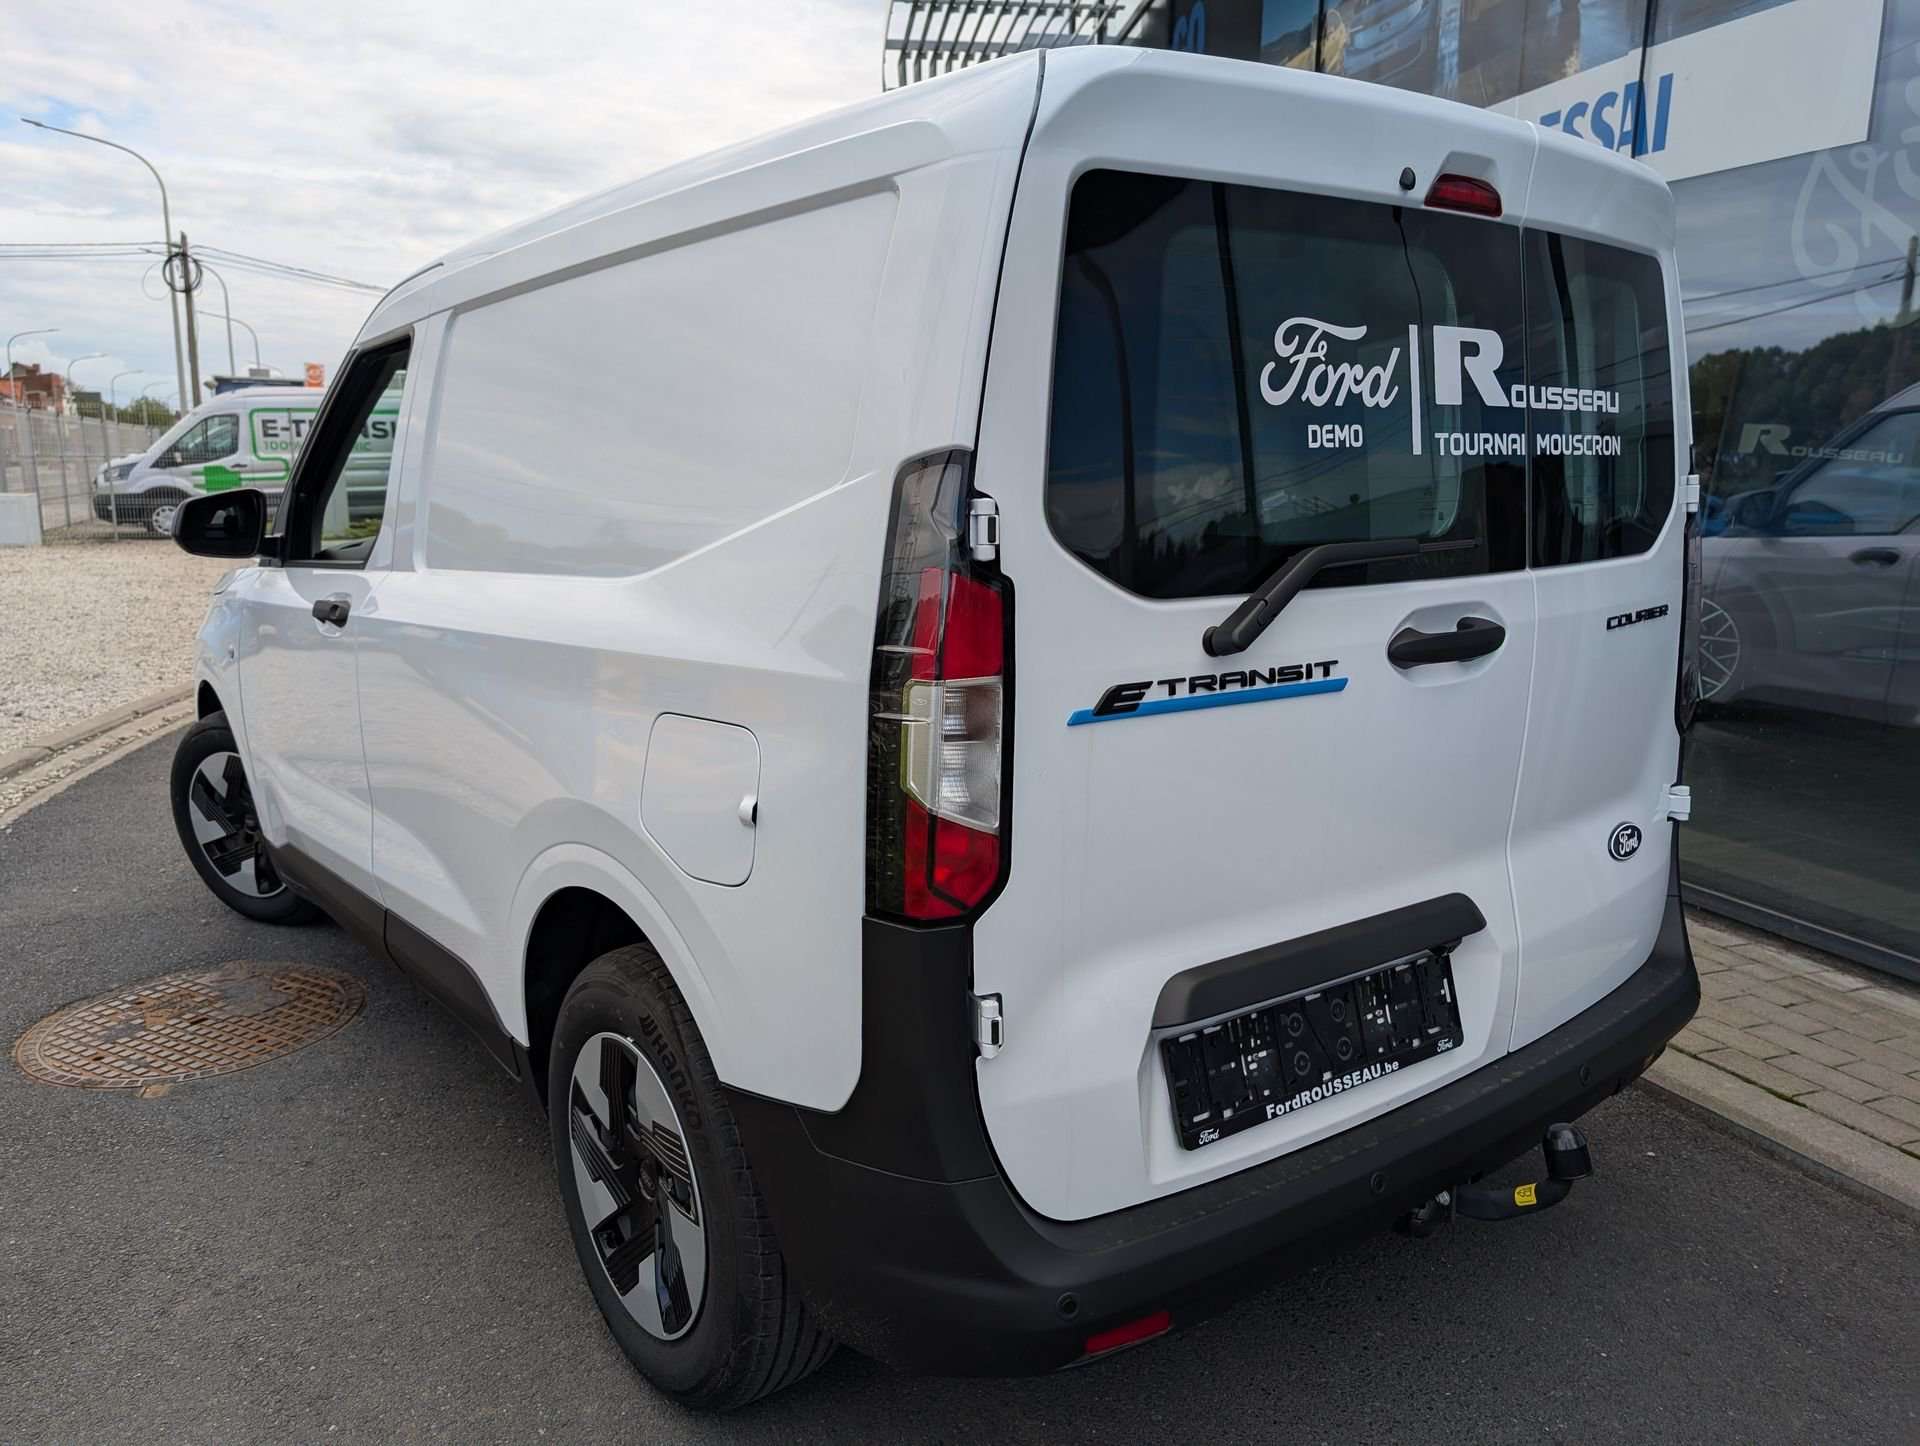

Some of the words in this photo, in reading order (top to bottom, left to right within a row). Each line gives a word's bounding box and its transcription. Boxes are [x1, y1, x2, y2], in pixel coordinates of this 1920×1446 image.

[1540, 72, 1674, 158] SSAI
[1260, 317, 1400, 409] Ford
[1307, 424, 1364, 449] DEMO
[1434, 432, 1526, 456] TOURNAI
[1536, 433, 1621, 456] MOUSCRON
[1606, 603, 1669, 631] COURIER
[1436, 1038, 1454, 1053] Ford
[1265, 1060, 1400, 1120] FordROUSSEAU.be
[1198, 1128, 1220, 1145] Ford
